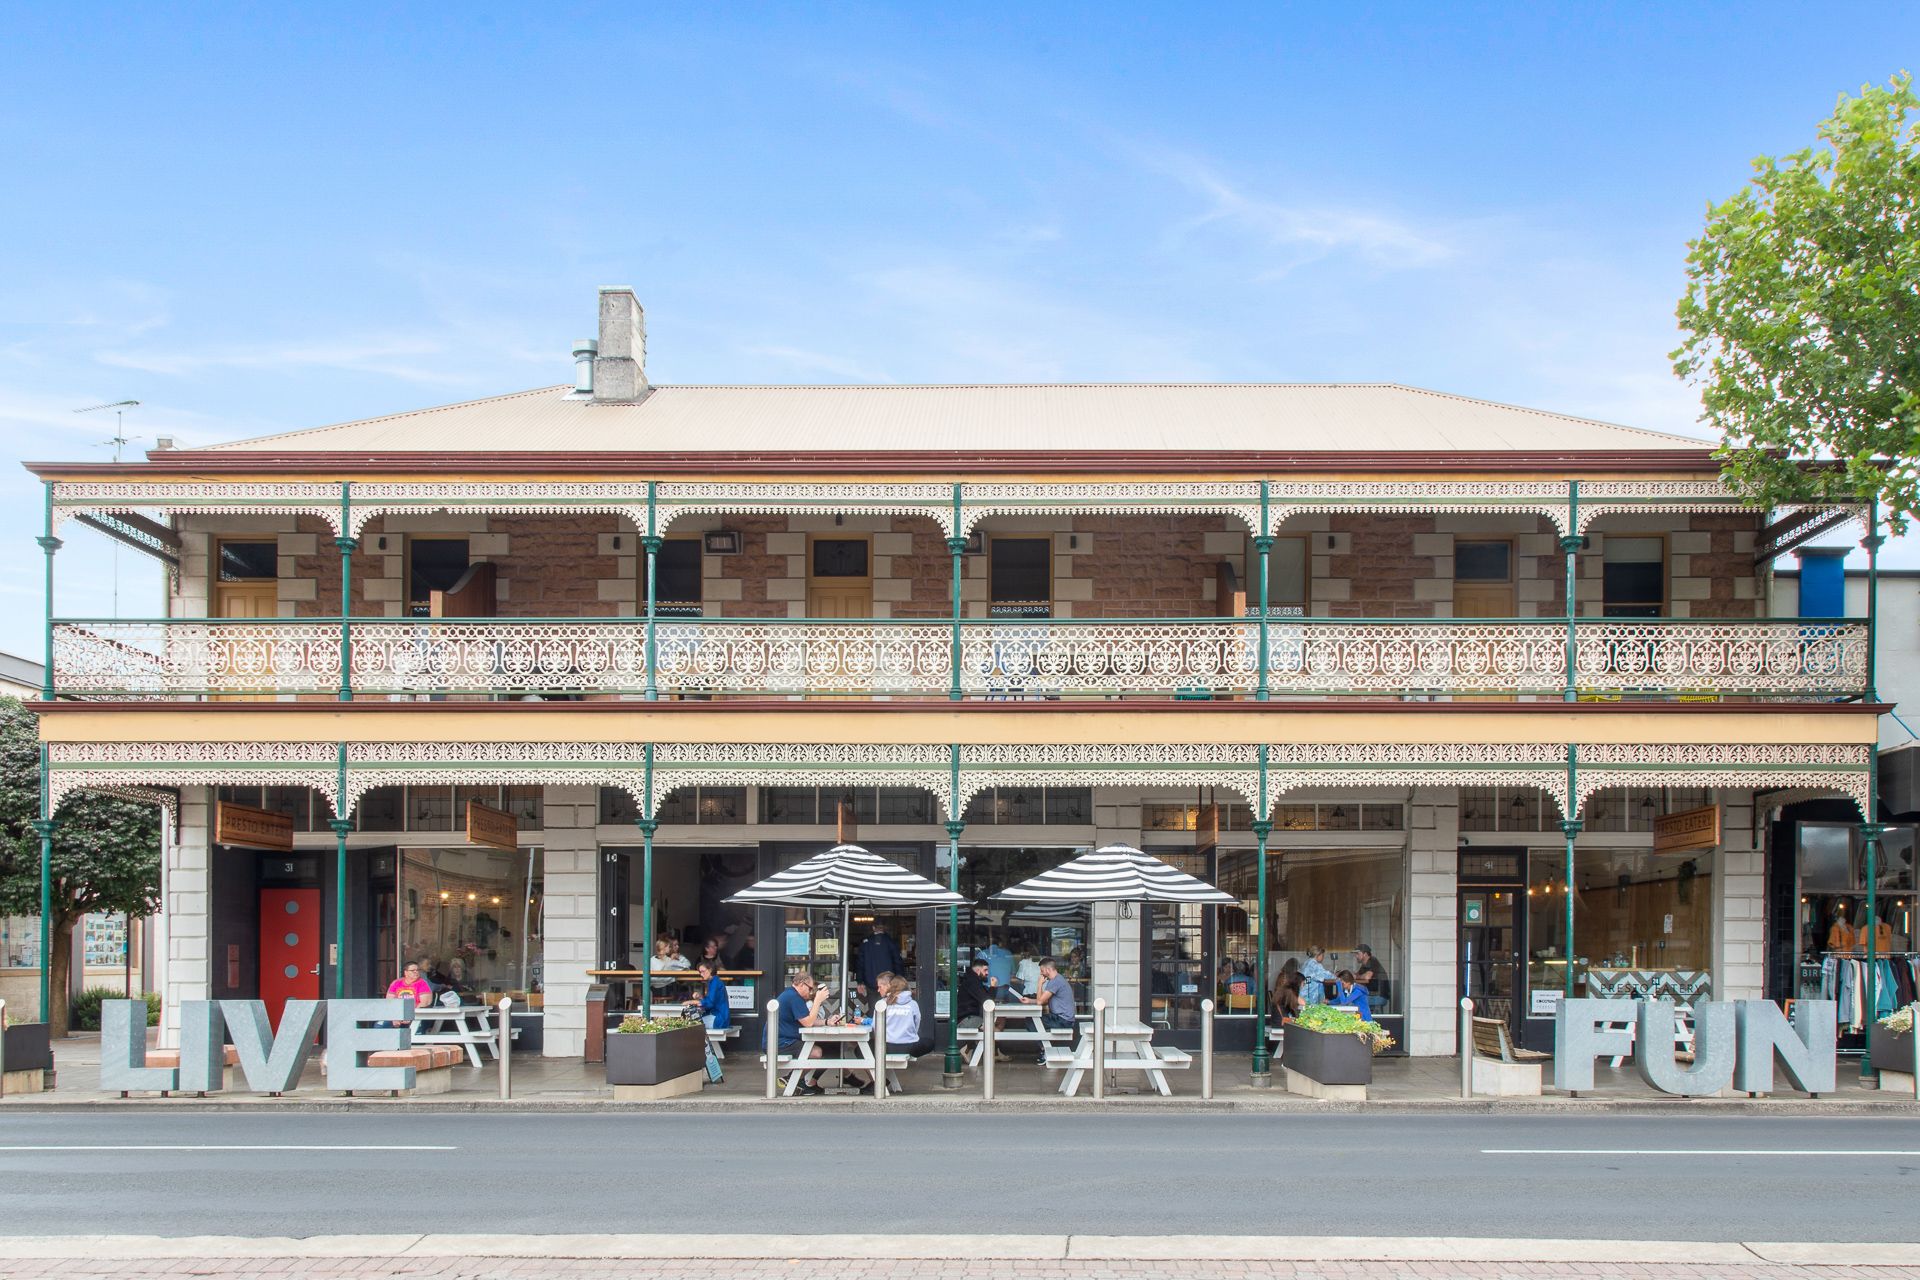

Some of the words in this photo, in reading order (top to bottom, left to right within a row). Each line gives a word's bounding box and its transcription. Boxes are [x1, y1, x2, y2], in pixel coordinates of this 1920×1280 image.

[226, 815, 258, 833] PRESTO
[1684, 815, 1712, 831] EATERY
[284, 863, 294, 872] 31
[1484, 861, 1494, 870] 41
[1600, 983, 1650, 994] PRESTO
[1655, 983, 1702, 994] EATERY
[101, 998, 417, 1092] LIVE
[1554, 999, 1838, 1096] FUN
